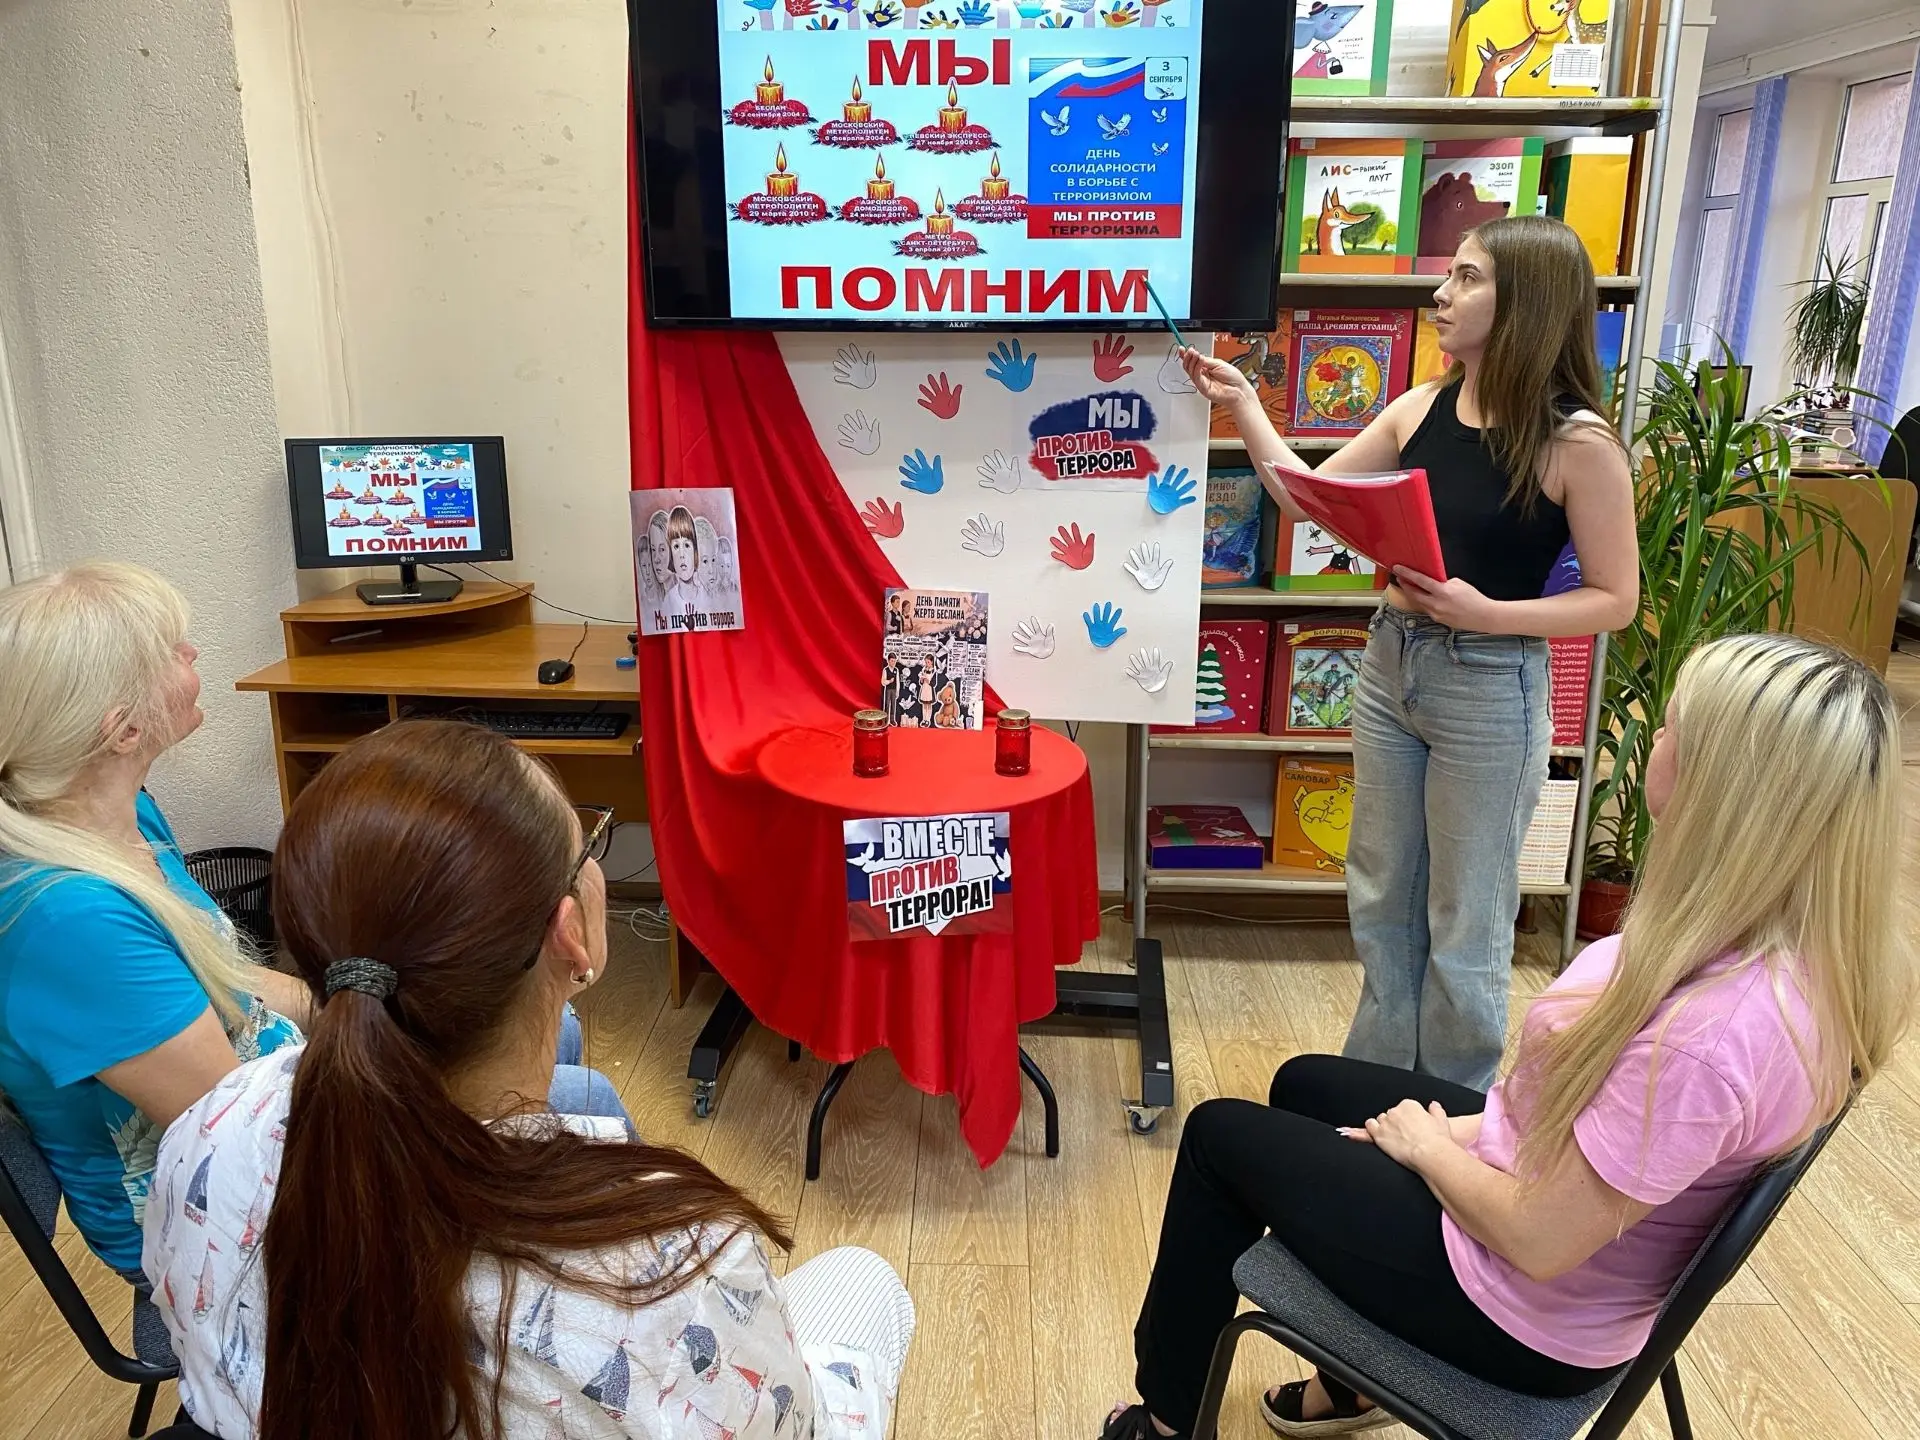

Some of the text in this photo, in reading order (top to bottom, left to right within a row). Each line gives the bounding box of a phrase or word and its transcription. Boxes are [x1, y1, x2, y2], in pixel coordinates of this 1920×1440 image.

[868, 38, 1011, 86] МЫ
[1162, 61, 1170, 71] 3
[1149, 75, 1183, 83] СЕНТЯБРЯ
[1085, 149, 1121, 160] ДЕНЬ
[1050, 163, 1156, 174] СОЛИДАРНОСТИ
[1489, 162, 1514, 170] ЭЗОП
[1067, 177, 1139, 186] В БОРЬБЕ С
[1369, 173, 1392, 182] ПЛУТ
[1053, 191, 1152, 201] ТЕРРОРИЗМОМ
[1053, 211, 1156, 221] МЫ ПРОТИВ
[1050, 225, 1160, 235] ТЕРРОРИЗМА
[780, 266, 1150, 314] ПОМНИМ
[1323, 323, 1359, 331] ДРЕВНЯЯ
[1361, 323, 1398, 331] СТОЛИЦА
[1088, 397, 1141, 429] МЫ
[1038, 430, 1112, 458] ПРОТИВ
[1056, 450, 1136, 477] ТЕРРОРА
[370, 472, 418, 487] МЫ
[345, 536, 468, 552] ПОМНИМ
[916, 595, 961, 608] ДЕНЬ ПАМЯТИ
[654, 609, 668, 630] Мы
[709, 611, 735, 629] террора
[913, 607, 965, 620] ЖЕРТВ БЕСЛАНА
[1313, 629, 1363, 637] БОРОДИНО
[1285, 772, 1330, 784] САМОВАР
[882, 817, 996, 860] ВМЕСТЕ
[871, 855, 959, 903] ПРОТИВ
[888, 879, 992, 930] ТЕРРОРА!
